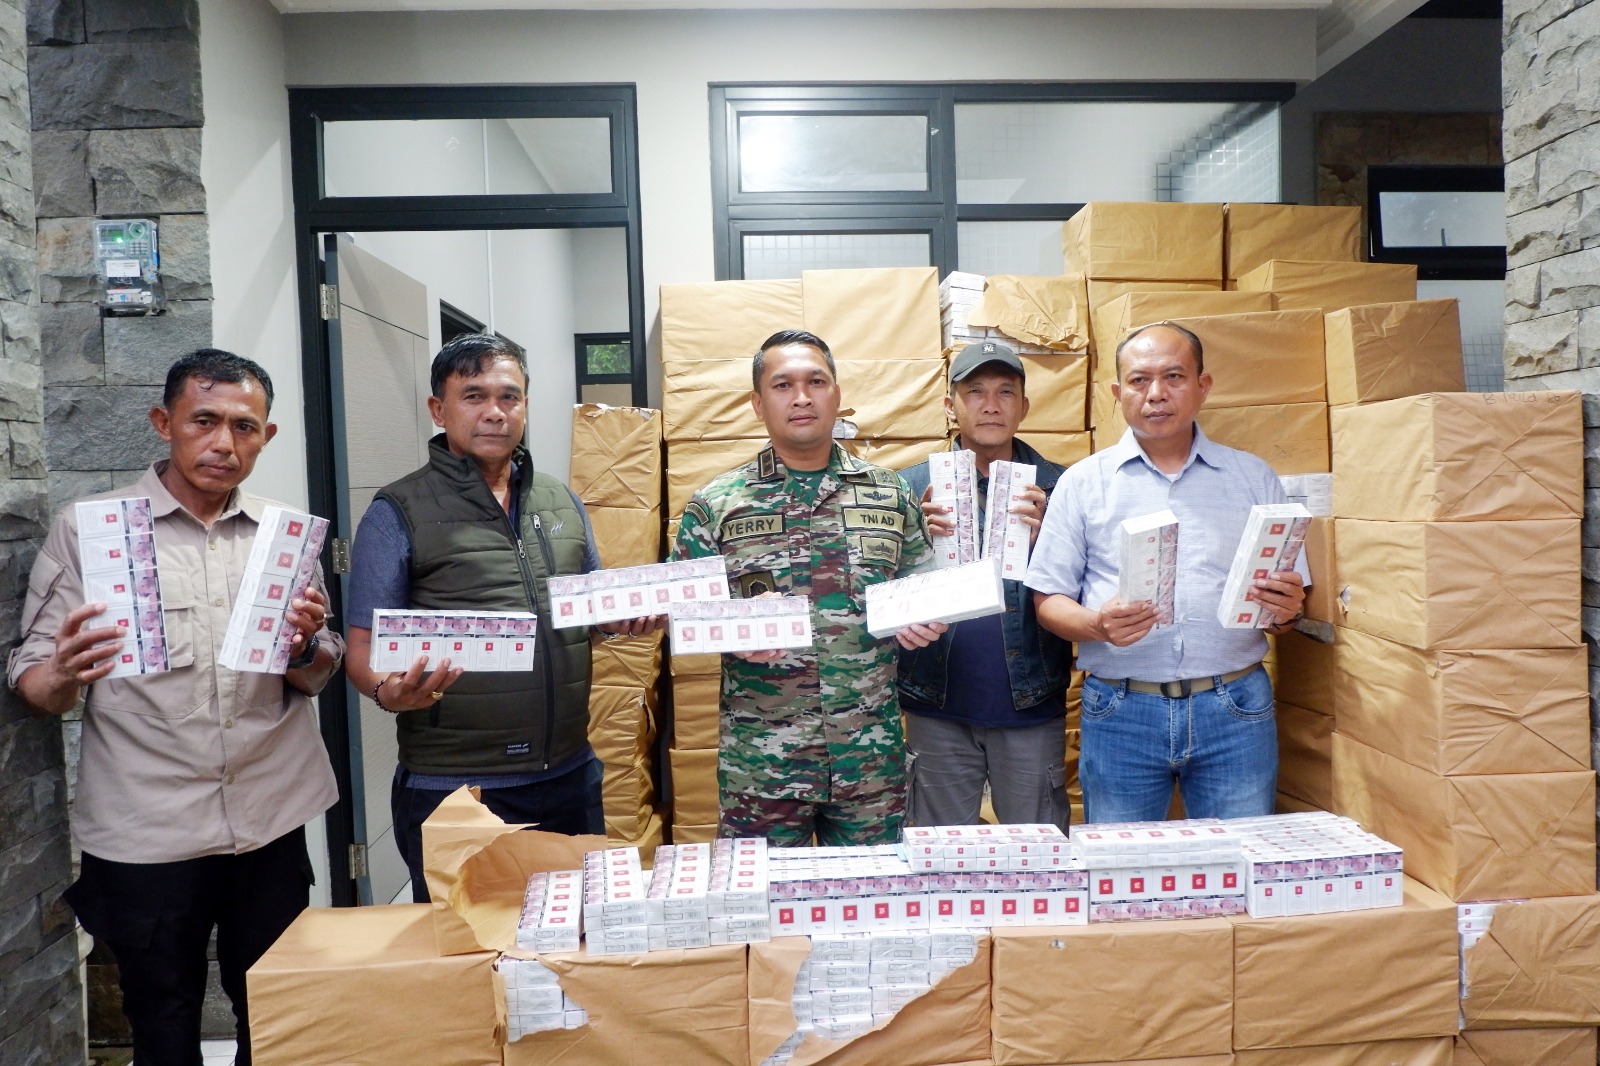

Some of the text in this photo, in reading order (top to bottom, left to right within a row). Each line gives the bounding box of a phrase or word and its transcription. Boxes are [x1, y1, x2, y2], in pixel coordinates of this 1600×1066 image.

[860, 514, 895, 526] TNI AD
[727, 519, 774, 536] YERRY
